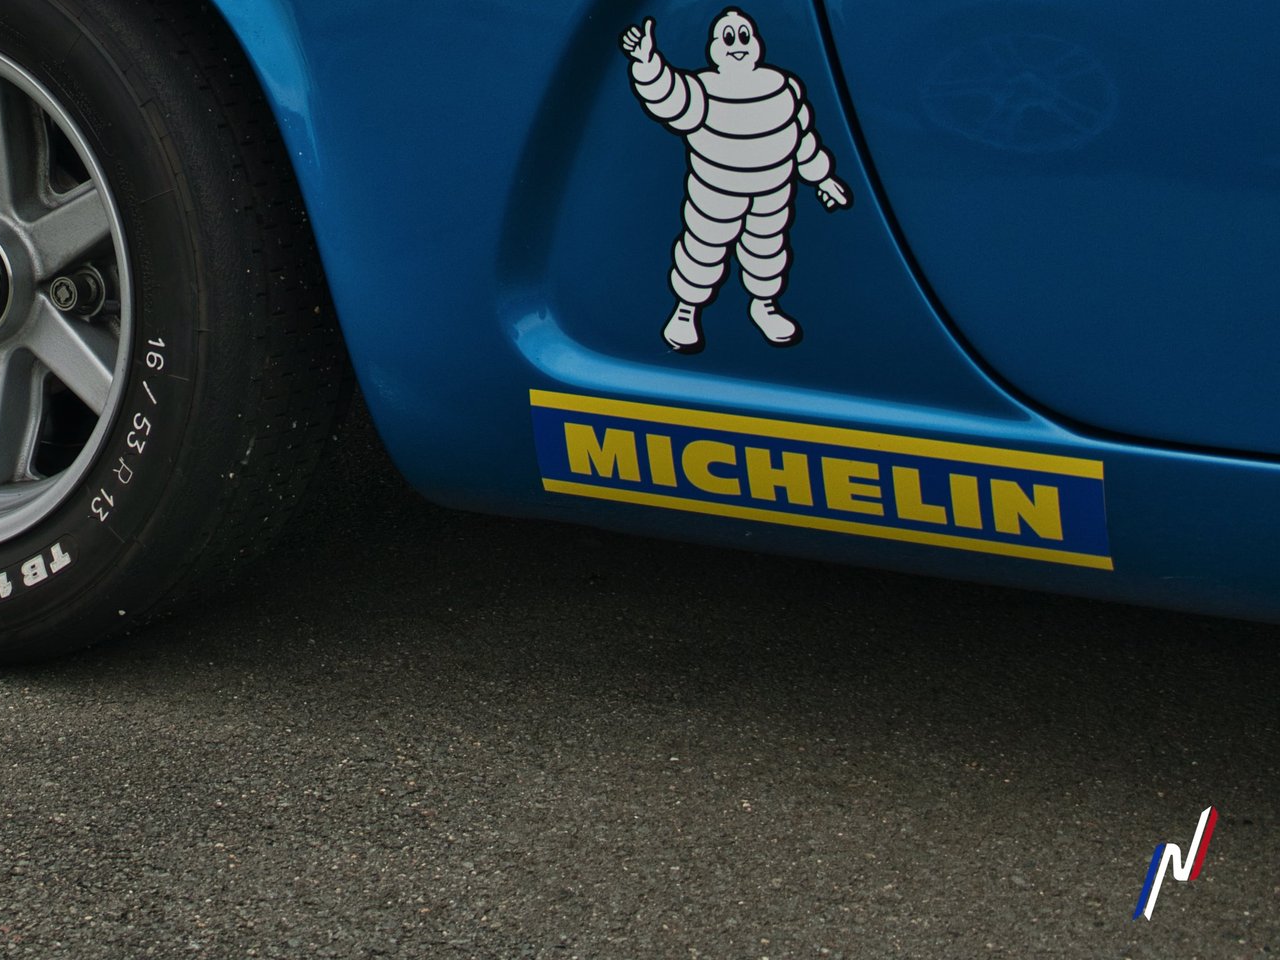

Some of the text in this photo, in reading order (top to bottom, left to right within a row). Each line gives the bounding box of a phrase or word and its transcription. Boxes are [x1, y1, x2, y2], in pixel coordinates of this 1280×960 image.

[146, 338, 165, 370] 16
[127, 412, 151, 453] 53
[113, 457, 133, 484] R
[563, 422, 1063, 540] MICHELIN
[91, 488, 114, 521] 13
